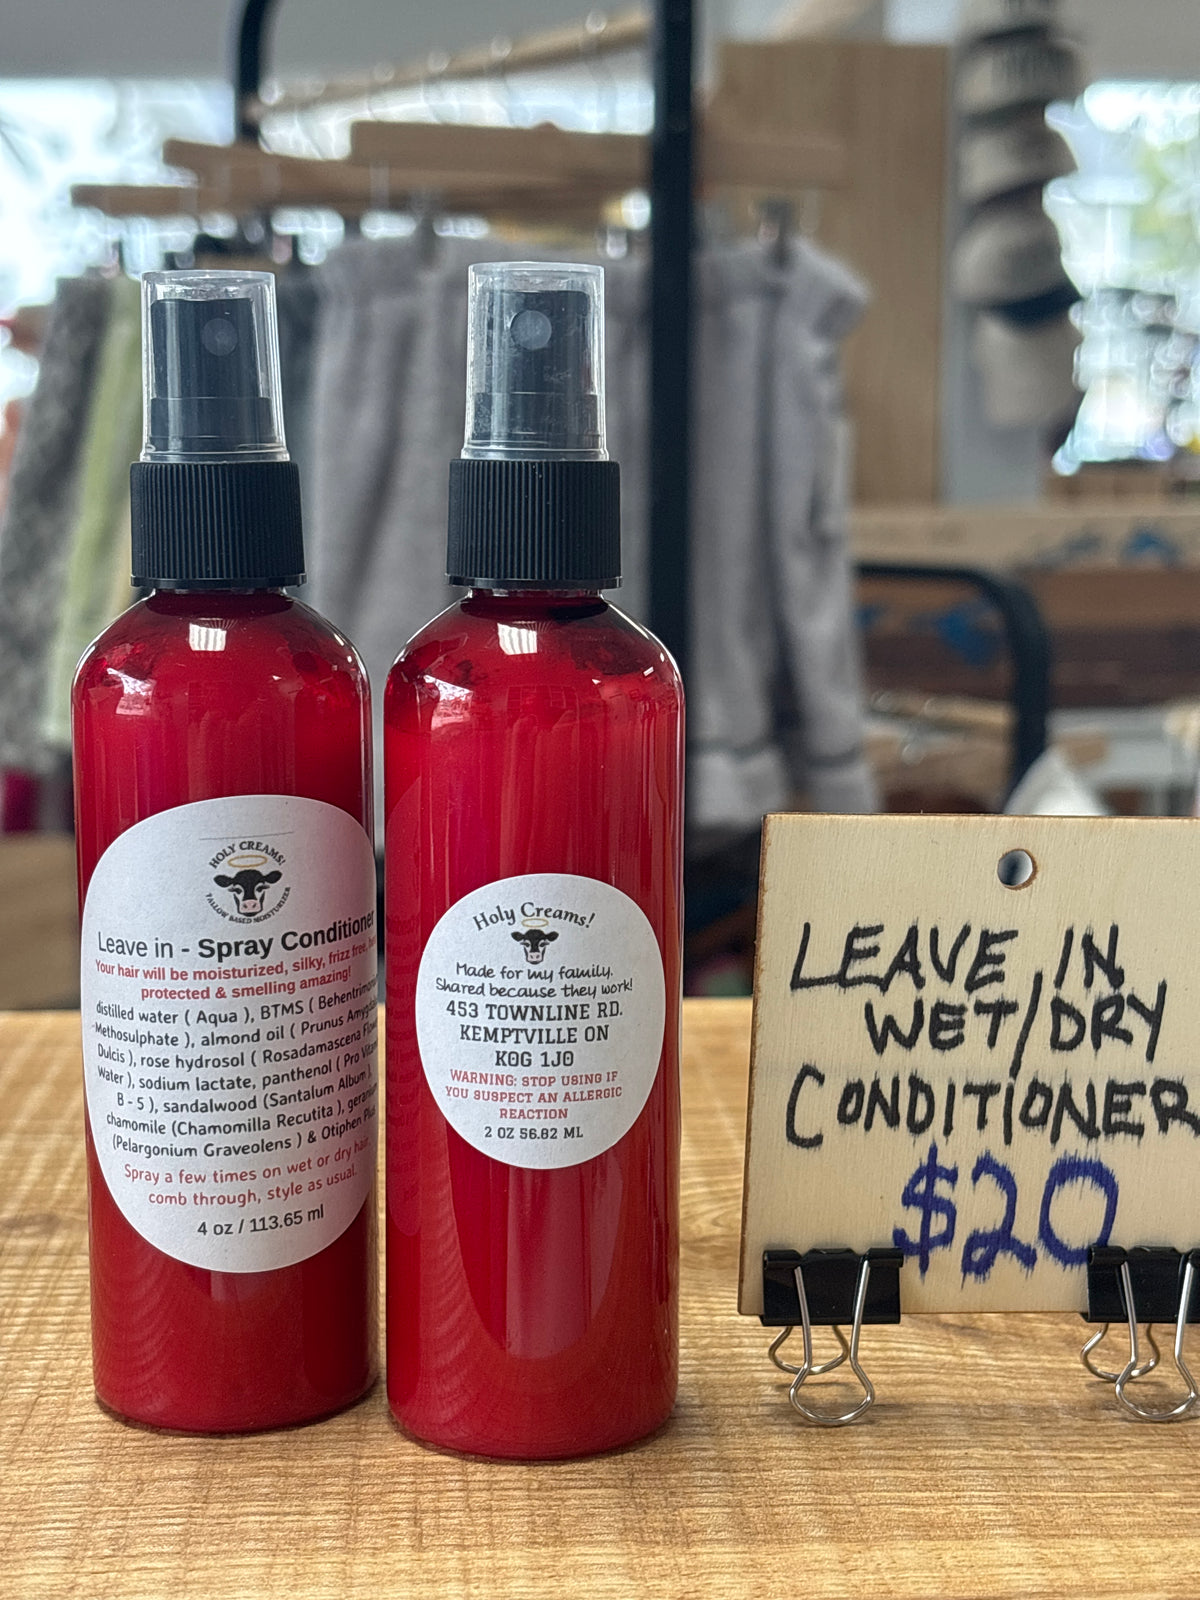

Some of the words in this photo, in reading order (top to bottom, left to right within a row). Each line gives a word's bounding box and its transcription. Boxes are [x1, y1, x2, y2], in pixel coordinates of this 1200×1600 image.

[208, 843, 236, 869] HOLY
[239, 840, 286, 866] CREAMS!
[205, 892, 229, 918] TALLOW
[472, 905, 516, 931] Holy
[520, 901, 596, 929] Creams!
[98, 931, 148, 957] Leave
[155, 937, 173, 958] in
[198, 937, 274, 963] Spray
[281, 910, 374, 951] Conditioner
[95, 959, 115, 975] Your
[118, 963, 140, 978] hair
[142, 967, 166, 980] will
[170, 968, 188, 981] be
[193, 961, 288, 981] moisturized,
[292, 956, 326, 973] silky,
[328, 950, 351, 964] frizz
[789, 916, 1019, 994] LEAVE
[1053, 920, 1125, 992] IN
[141, 986, 210, 1001] protected
[215, 986, 227, 999] &
[232, 981, 296, 998] smelling
[299, 966, 351, 989] amazing!
[435, 977, 485, 997] Shared
[489, 983, 557, 998] because
[561, 984, 597, 999] they
[601, 978, 633, 996] work!
[456, 962, 495, 979] Made
[500, 965, 523, 980] for
[528, 969, 553, 983] my
[558, 963, 613, 980] family.
[96, 1000, 134, 1020] distilled
[138, 1010, 178, 1024] water
[196, 1010, 237, 1028] Aqua
[260, 1000, 304, 1020] BTMS
[446, 1000, 479, 1018] 453
[485, 1003, 590, 1022] TOWNLINE
[597, 1000, 623, 1018] RD.
[863, 969, 1167, 1083] WET/DRY
[201, 1028, 260, 1046] almond
[266, 1026, 284, 1041] oil
[301, 1016, 344, 1035] Prunus
[460, 1024, 577, 1044] KEMPTVILLE
[584, 1025, 609, 1042] ON
[98, 1043, 125, 1063] Dulcis
[140, 1056, 170, 1068] rose
[175, 1052, 244, 1072] hydrosol
[263, 1030, 361, 1064] Rosadamascena
[97, 1065, 123, 1084] Water
[139, 1076, 190, 1091] sodium
[196, 1076, 256, 1091] lactate,
[262, 1060, 332, 1089] panthenol
[344, 1053, 360, 1068] Pro
[450, 1069, 517, 1087] WARNING:
[521, 1076, 557, 1087] STOP
[561, 1073, 602, 1087] USING
[606, 1071, 618, 1082] IF
[163, 1094, 257, 1113] sandalwood
[263, 1085, 334, 1109] (Santalum
[338, 1071, 366, 1091] Album
[445, 1086, 469, 1099] YOU
[473, 1089, 533, 1104] SUSPECT
[537, 1092, 558, 1104] AN
[563, 1086, 622, 1102] ALLERGIC
[786, 1061, 1200, 1150] CONDITIONER
[106, 1112, 166, 1134] chamomile
[172, 1115, 271, 1137] (Chamomilla
[277, 1105, 334, 1128] Recutita
[499, 1108, 568, 1120] REACTION
[112, 1134, 197, 1158] (Pelargonium
[203, 1138, 291, 1157] Graveolens
[308, 1130, 316, 1144] &
[321, 1116, 361, 1140] Otiphen
[484, 1126, 492, 1138] 2
[497, 1127, 514, 1140] OZ
[519, 1127, 557, 1140] 56.82
[563, 1126, 583, 1139] ML
[124, 1163, 159, 1185] Spray
[165, 1172, 173, 1183] a
[178, 1169, 206, 1183] few
[213, 1169, 257, 1184] times
[262, 1166, 281, 1179] on
[287, 1158, 312, 1173] wet
[317, 1155, 330, 1168] or
[334, 1147, 352, 1162] dry
[149, 1192, 187, 1206] comb
[193, 1189, 261, 1208] through,
[267, 1181, 303, 1201] style
[308, 1179, 322, 1192] as
[326, 1162, 357, 1186] usual.
[197, 1221, 207, 1236] 4
[213, 1223, 233, 1236] oz
[250, 1209, 303, 1232] 113.65
[308, 1204, 324, 1222] ml
[892, 1140, 1120, 1288] $20
